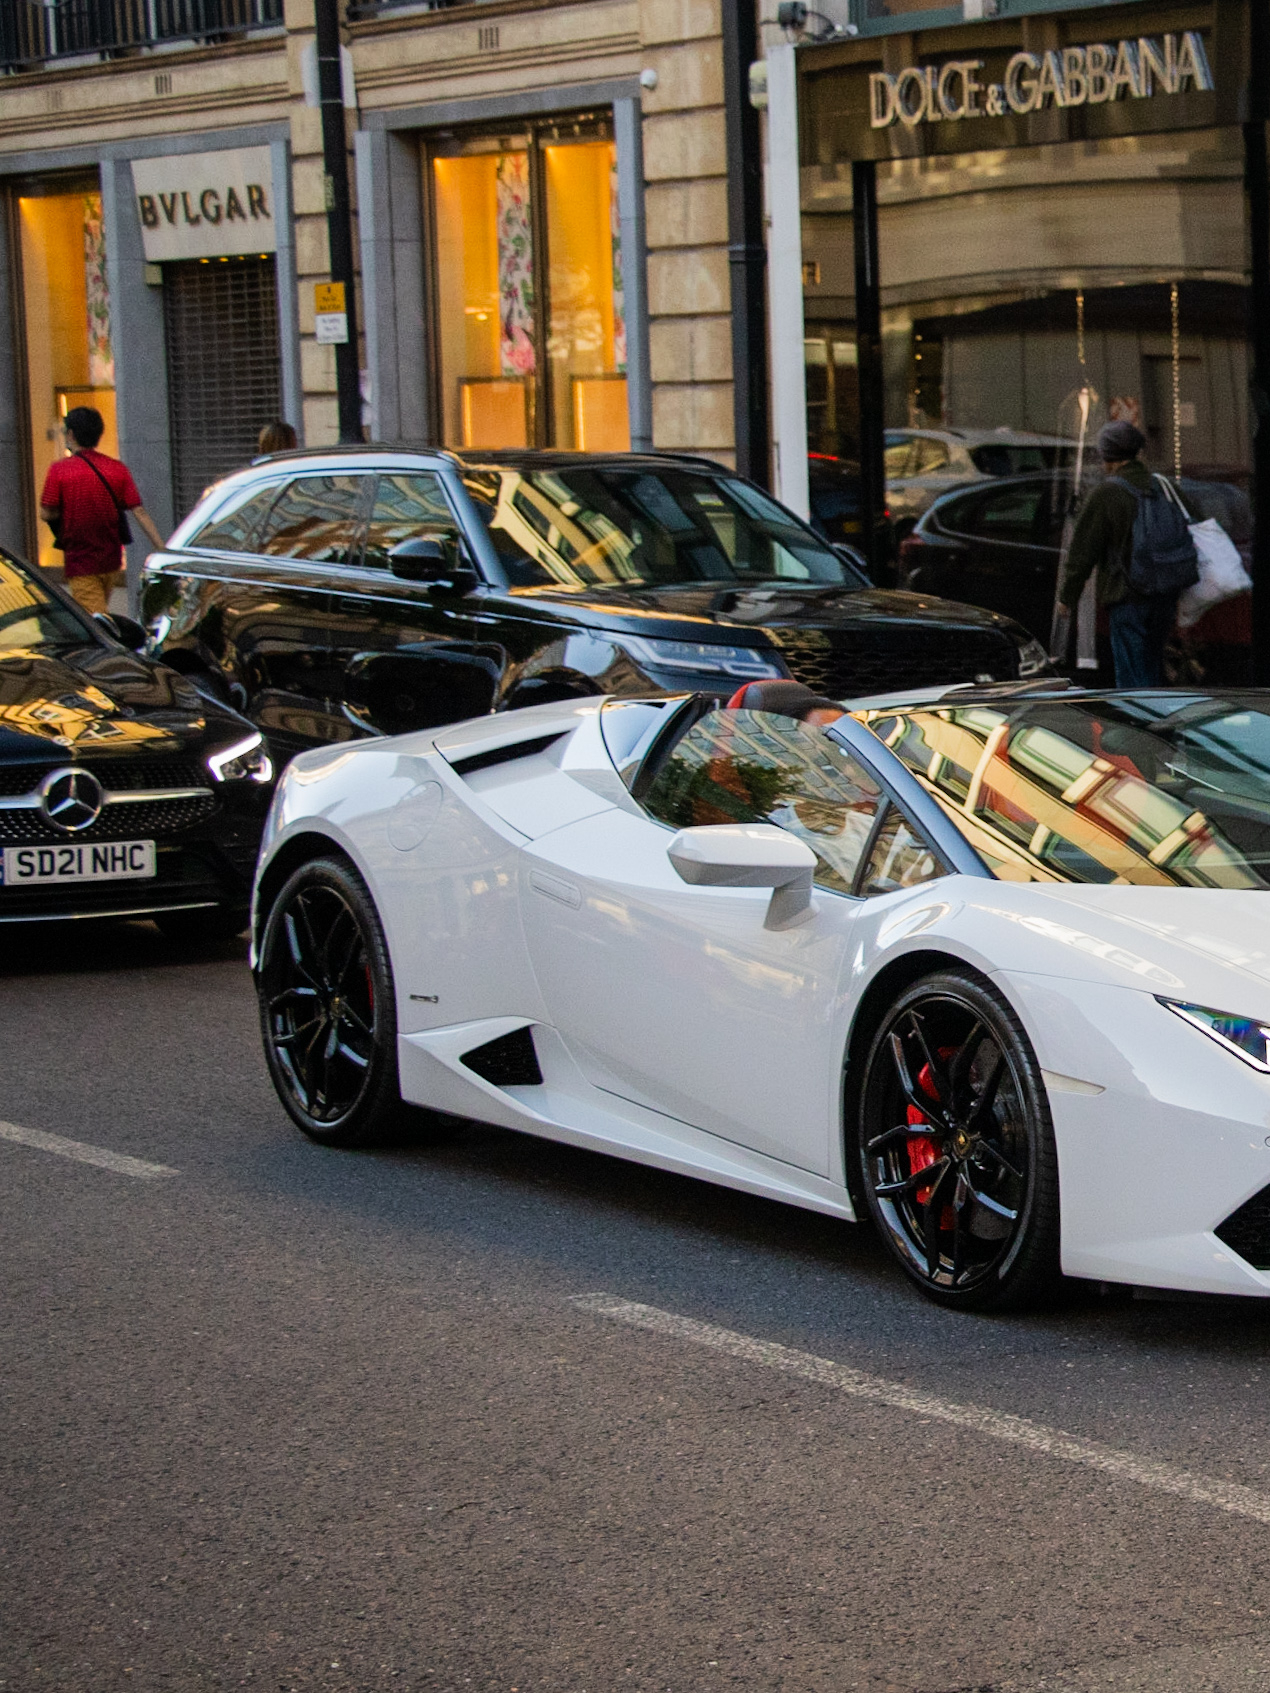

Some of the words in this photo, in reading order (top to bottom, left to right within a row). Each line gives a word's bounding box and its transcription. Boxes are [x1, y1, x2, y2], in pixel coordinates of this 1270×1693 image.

[139, 184, 271, 229] BVLGAR
[17, 848, 83, 877] SD21
[92, 844, 145, 873] NHC
